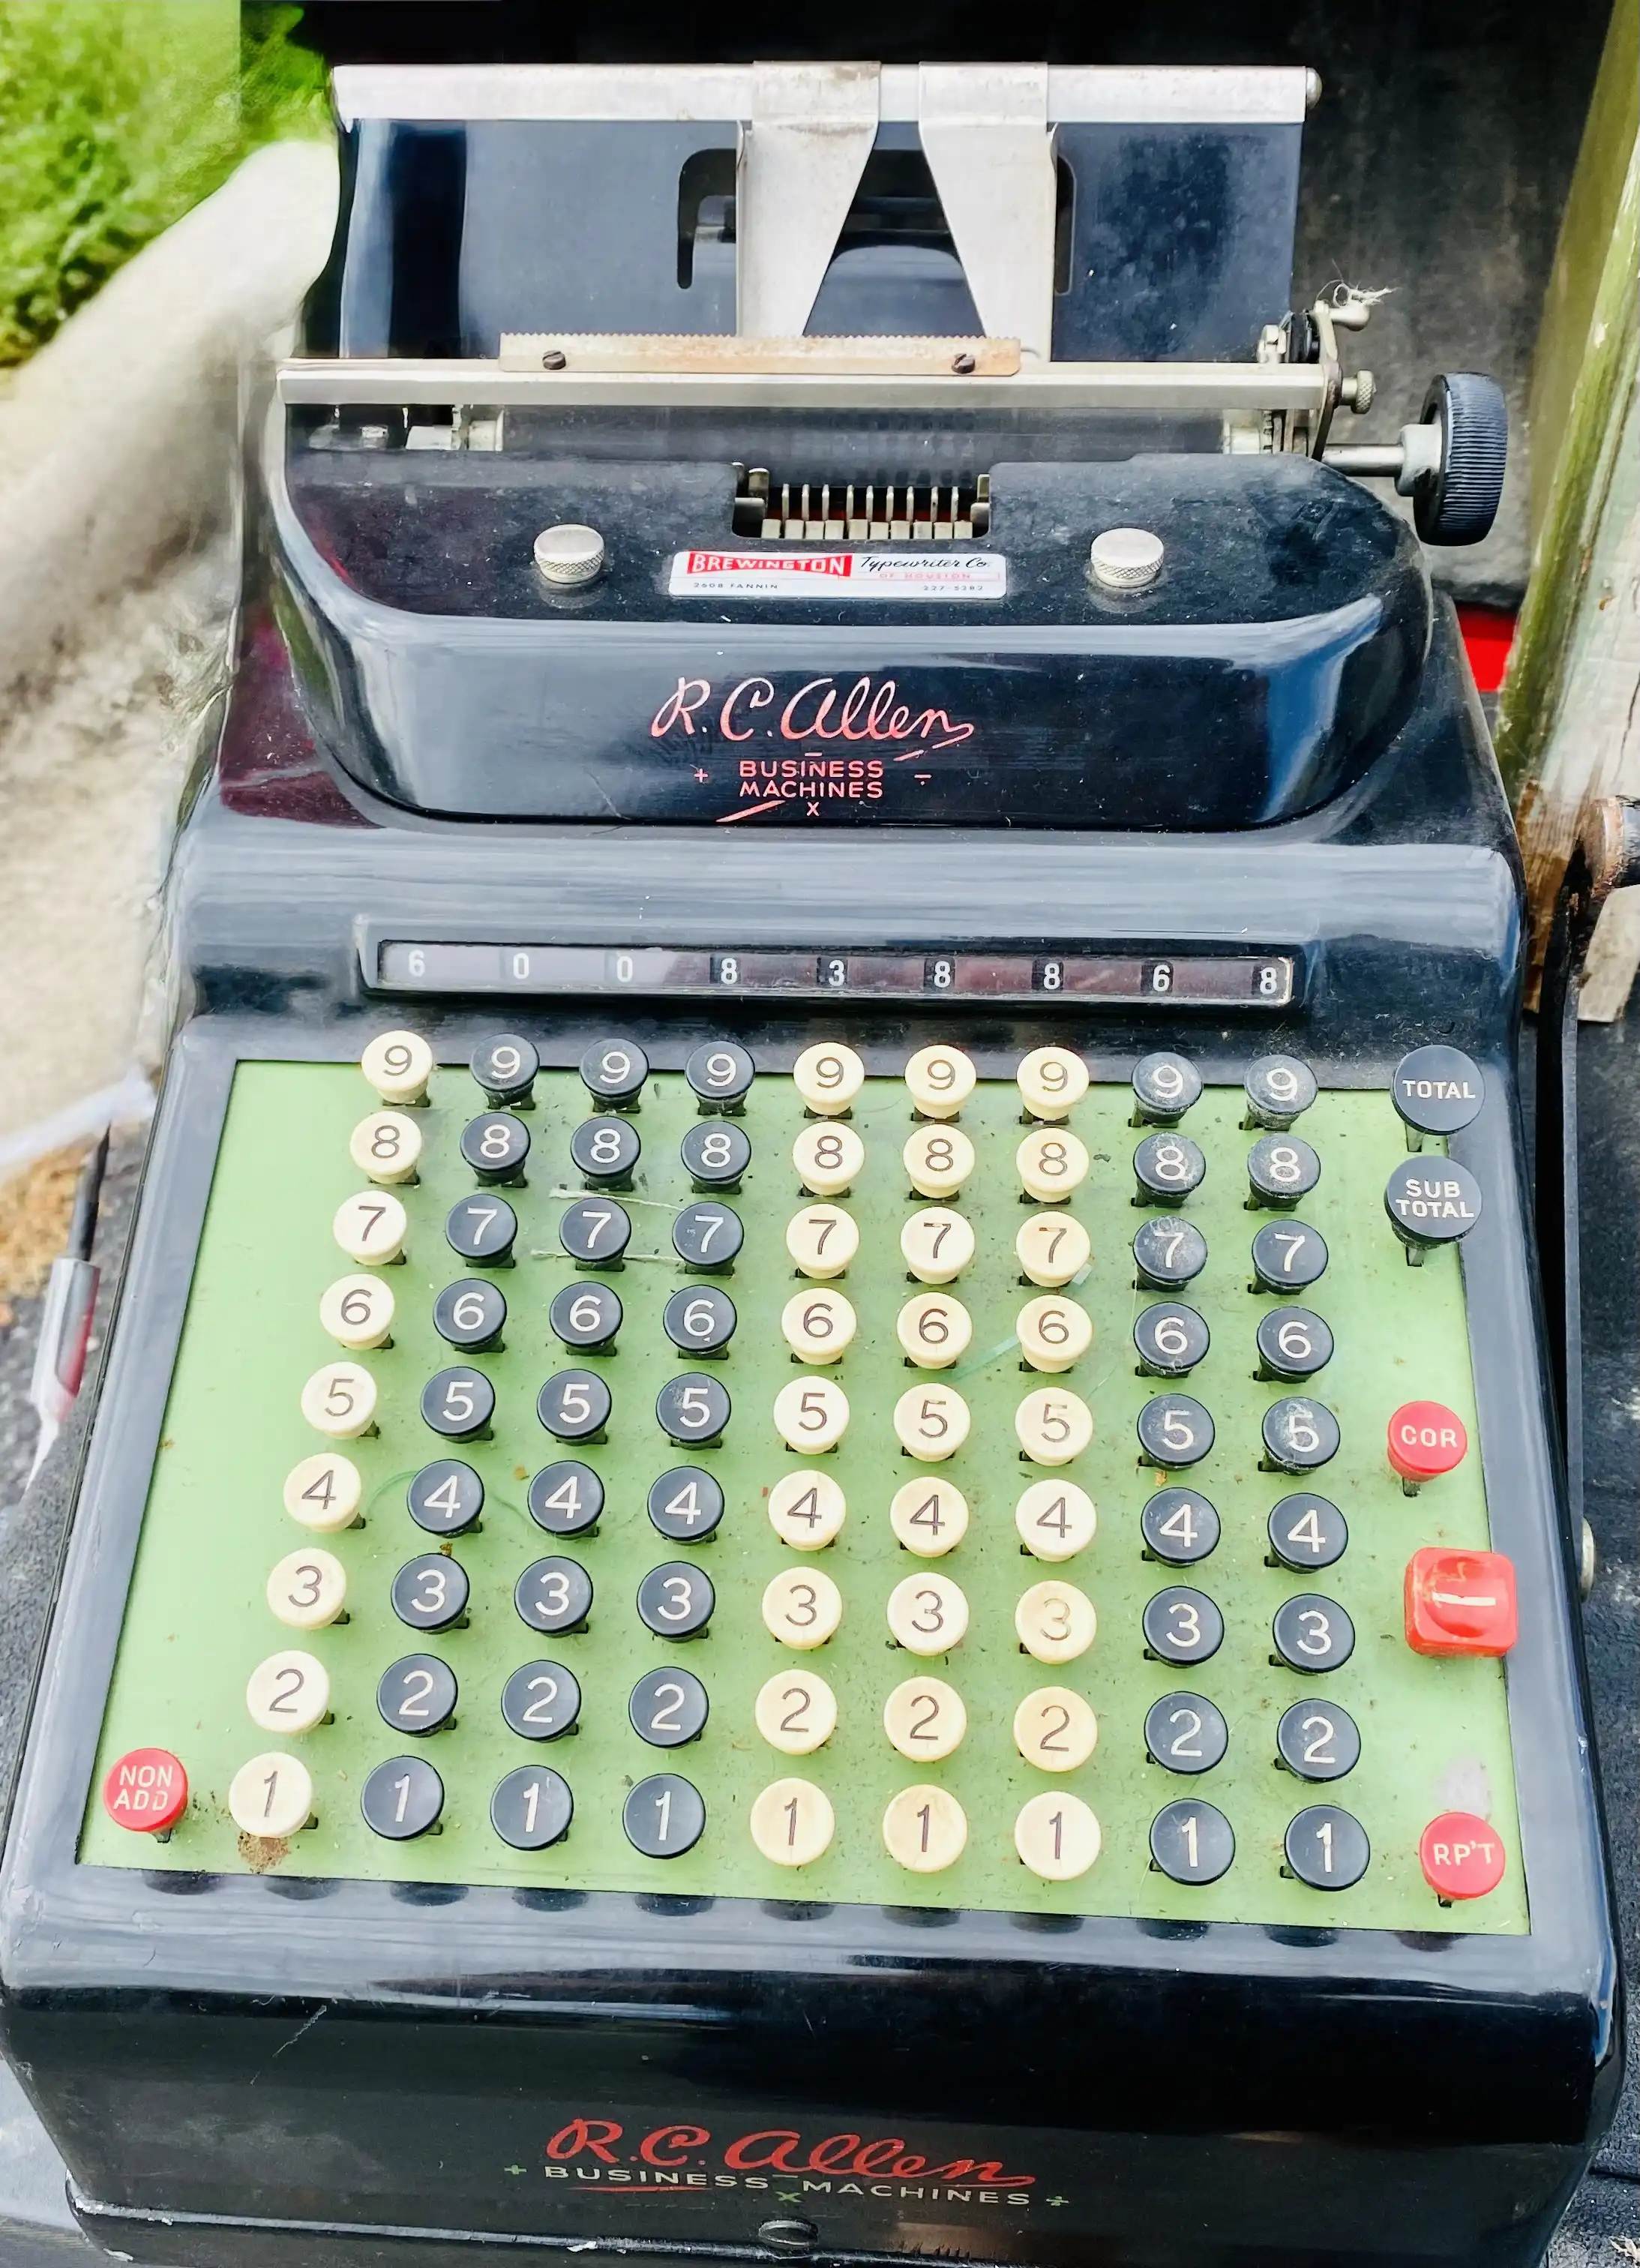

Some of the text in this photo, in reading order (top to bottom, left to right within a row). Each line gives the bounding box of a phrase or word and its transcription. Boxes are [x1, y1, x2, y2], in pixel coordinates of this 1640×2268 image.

[691, 553, 845, 575] BREWINGTON
[861, 556, 961, 572] Typewriter
[739, 760, 884, 778] BUSINESS
[739, 781, 883, 799] MACHINES
[408, 950, 1278, 994] 6 0 0 8 3 8 8 6 8
[384, 1046, 412, 1076] 9
[492, 1047, 520, 1078] 9
[602, 1052, 630, 1083] 9
[707, 1054, 736, 1086] 9
[816, 1057, 844, 1088] 9
[928, 1060, 955, 1090] 9
[1040, 1062, 1068, 1092] 9
[1152, 1064, 1183, 1098] 9
[1267, 1067, 1300, 1100] 9
[1402, 1080, 1476, 1100] TOTAL
[371, 1125, 400, 1159] 8
[481, 1125, 510, 1158] 8
[591, 1129, 620, 1162] 8
[702, 1134, 730, 1167] 8
[814, 1136, 842, 1169] 8
[925, 1138, 953, 1172] 8
[1039, 1142, 1067, 1175] 8
[1156, 1146, 1185, 1180] 8
[1270, 1148, 1300, 1181] 8
[1405, 1178, 1461, 1199] SUB
[358, 1206, 385, 1241] 7
[468, 1208, 497, 1244] 7
[1395, 1198, 1475, 1218] TOTAL
[583, 1212, 611, 1248] 7
[695, 1216, 724, 1252] 7
[809, 1220, 836, 1255] 7
[923, 1223, 951, 1258] 7
[1039, 1227, 1066, 1263] 7
[1155, 1231, 1183, 1268] 7
[1276, 1234, 1305, 1271] 7
[341, 1289, 372, 1325] 6
[454, 1293, 484, 1329] 6
[570, 1295, 601, 1331] 6
[685, 1300, 714, 1336] 6
[803, 1304, 833, 1338] 6
[919, 1309, 949, 1344] 6
[1039, 1310, 1069, 1344] 6
[1155, 1318, 1187, 1354] 6
[1279, 1322, 1312, 1358] 6
[325, 1378, 354, 1417] 5
[443, 1382, 473, 1420] 5
[560, 1384, 590, 1421] 5
[680, 1388, 709, 1426] 5
[799, 1393, 827, 1431] 5
[919, 1400, 948, 1438] 5
[1042, 1403, 1070, 1442] 5
[1162, 1411, 1194, 1450] 5
[1288, 1409, 1319, 1452] 5
[1401, 1425, 1458, 1448] COR
[301, 1470, 336, 1510] 4
[424, 1475, 460, 1517] 4
[546, 1476, 581, 1519] 4
[666, 1482, 700, 1525] 4
[787, 1487, 822, 1528] 4
[910, 1495, 945, 1535] 4
[1036, 1497, 1072, 1538] 4
[1160, 1504, 1198, 1547] 4
[1288, 1510, 1326, 1552] 4
[289, 1565, 322, 1607] 3
[412, 1570, 445, 1612] 3
[535, 1573, 569, 1616] 3
[658, 1578, 691, 1619] 3
[785, 1585, 817, 1626] 3
[912, 1591, 943, 1633] 3
[1041, 1598, 1071, 1640] 3
[1167, 1604, 1200, 1646] 3
[1297, 1611, 1331, 1654] 3
[270, 1669, 304, 1713] 2
[399, 1671, 433, 1717] 2
[523, 1677, 557, 1723] 2
[651, 1684, 685, 1730] 2
[781, 1688, 810, 1732] 2
[910, 1696, 939, 1740] 2
[1040, 1706, 1069, 1751] 2
[1171, 1710, 1202, 1755] 2
[1303, 1717, 1335, 1762] 2
[119, 1765, 173, 1788] NON
[264, 1771, 277, 1817] 1
[112, 1788, 169, 1811] ADD
[395, 1776, 409, 1825] 1
[524, 1783, 538, 1832] 1
[656, 1792, 670, 1839] 1
[784, 1798, 797, 1845] 1
[917, 1804, 929, 1852] 1
[1049, 1811, 1062, 1859] 1
[1182, 1818, 1198, 1870] 1
[1317, 1823, 1331, 1875] 1
[544, 2166, 1030, 2206] BUSINESS MACHINES
